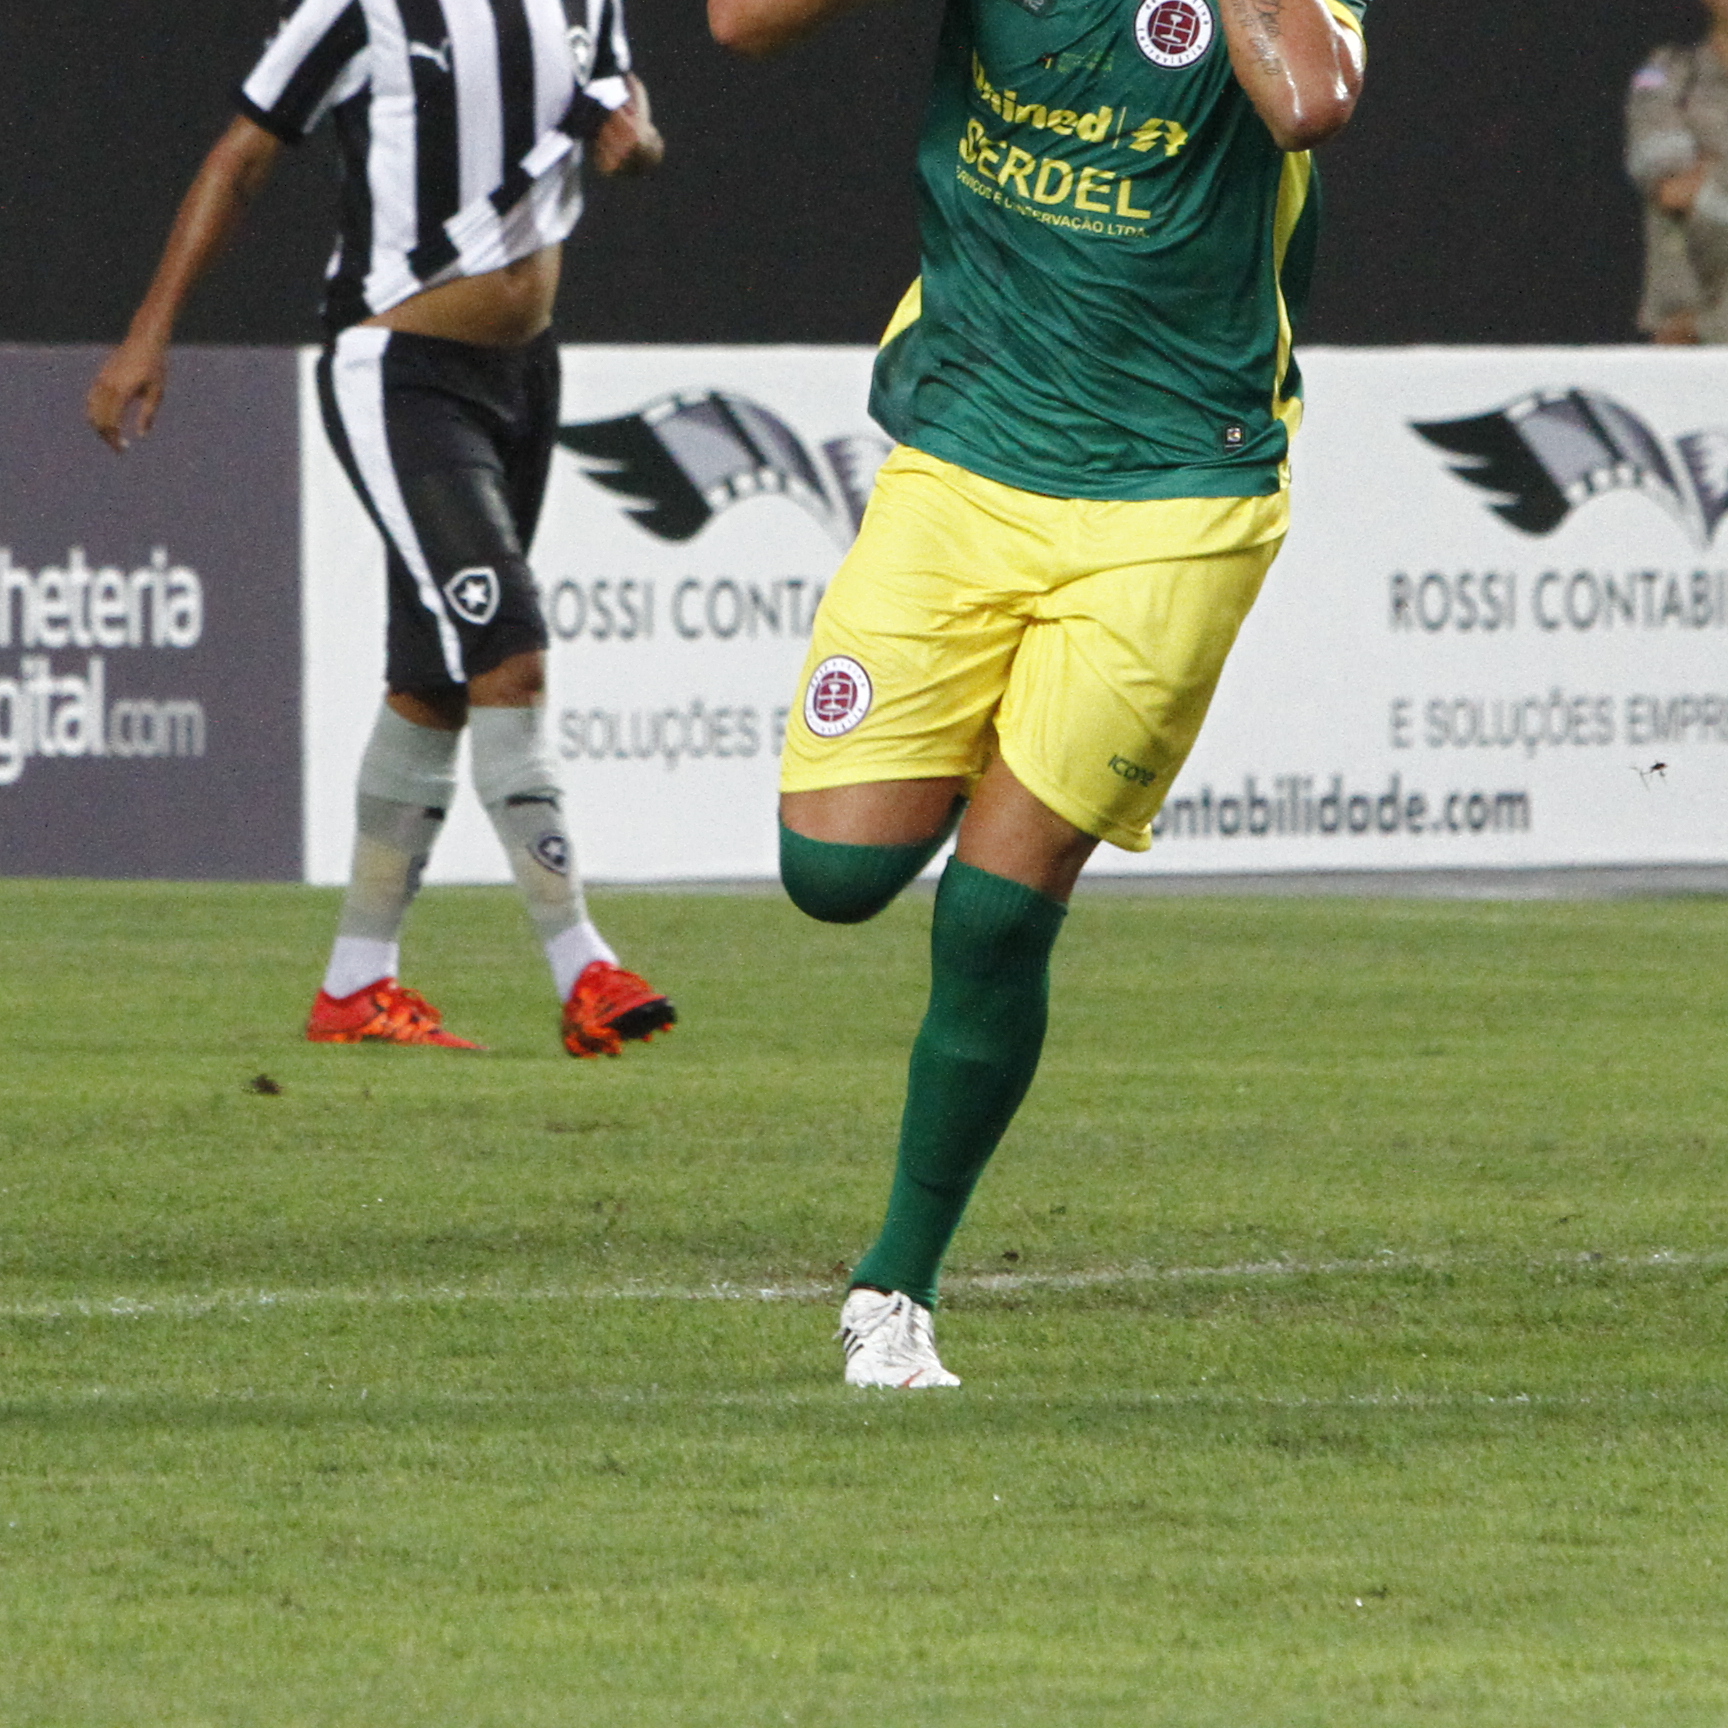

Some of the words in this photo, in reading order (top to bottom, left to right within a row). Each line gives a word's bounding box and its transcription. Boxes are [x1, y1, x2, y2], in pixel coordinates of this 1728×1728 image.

[958, 117, 1152, 220] SERDEL
[548, 576, 656, 642] OSSI
[1387, 570, 1517, 634] ROSSI
[558, 698, 760, 771] SOLUÇÕES
[1388, 695, 1413, 749] E
[1425, 686, 1614, 760] SOLUÇÕES
